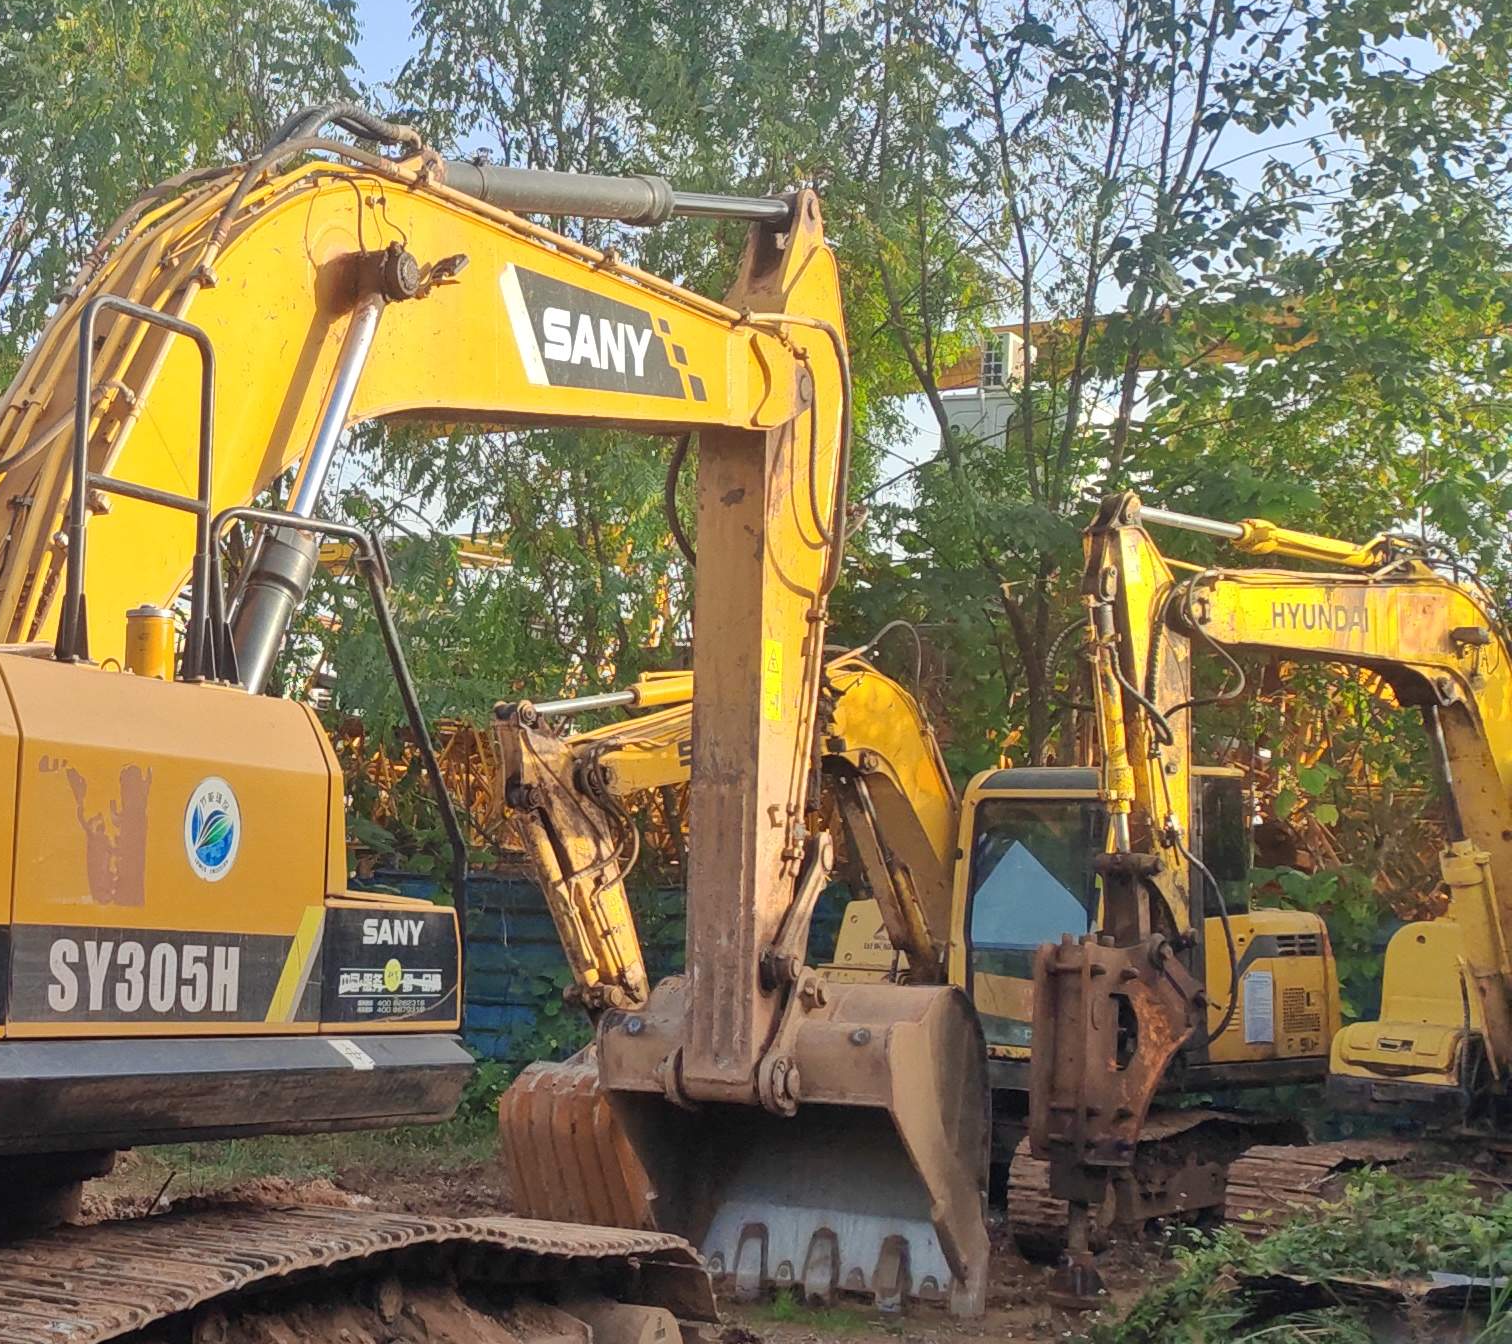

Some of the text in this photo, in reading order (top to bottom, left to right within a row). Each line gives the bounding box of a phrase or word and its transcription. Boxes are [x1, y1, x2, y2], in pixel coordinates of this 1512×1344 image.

[543, 307, 652, 377] SANY
[1272, 602, 1369, 633] HYUNDAI
[363, 918, 425, 946] SANY
[48, 938, 240, 1012] SY305H
